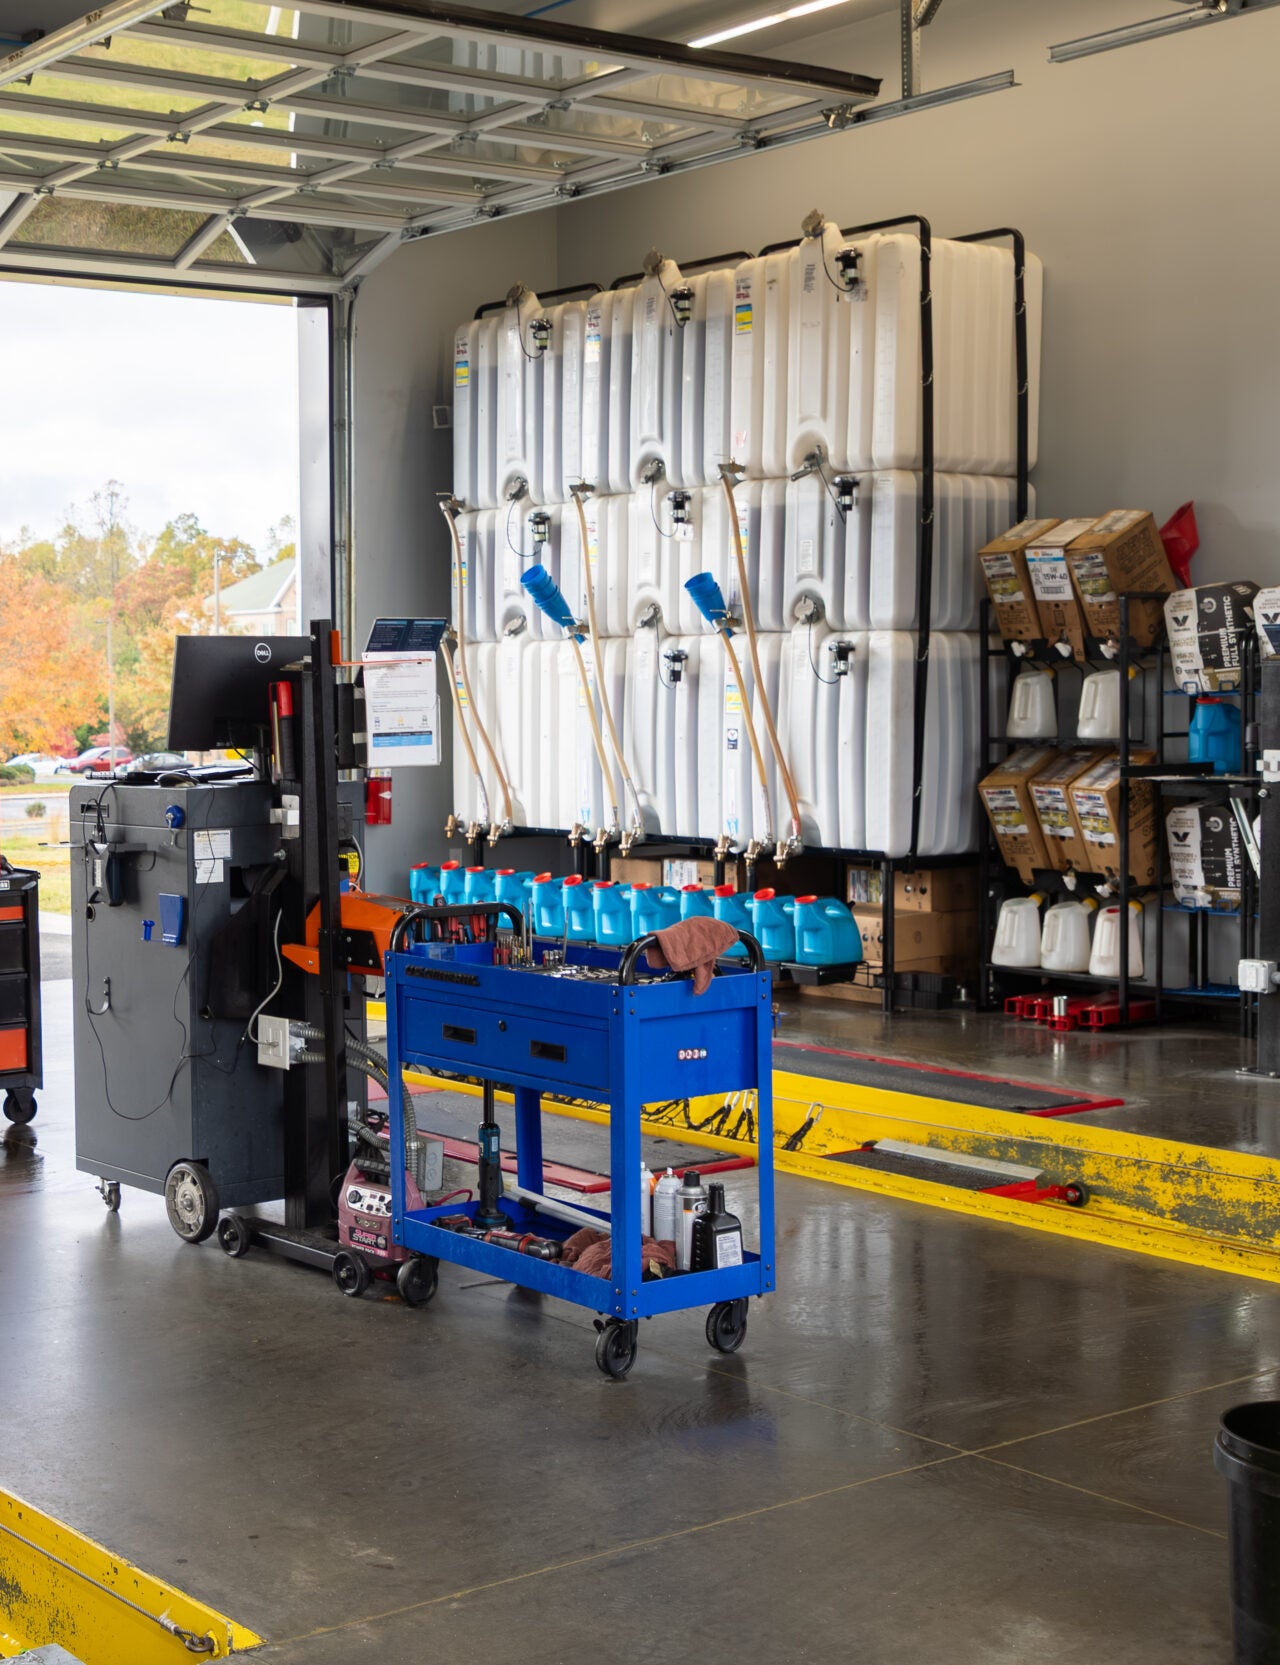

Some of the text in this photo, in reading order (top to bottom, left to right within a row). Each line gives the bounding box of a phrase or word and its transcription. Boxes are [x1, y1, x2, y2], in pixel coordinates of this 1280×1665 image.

[1219, 628, 1231, 667] PREMIUM
[1230, 645, 1240, 666] FULL
[1224, 848, 1236, 887] PREMIUM
[352, 1233, 376, 1246] START
[355, 1229, 376, 1240] SUPER
